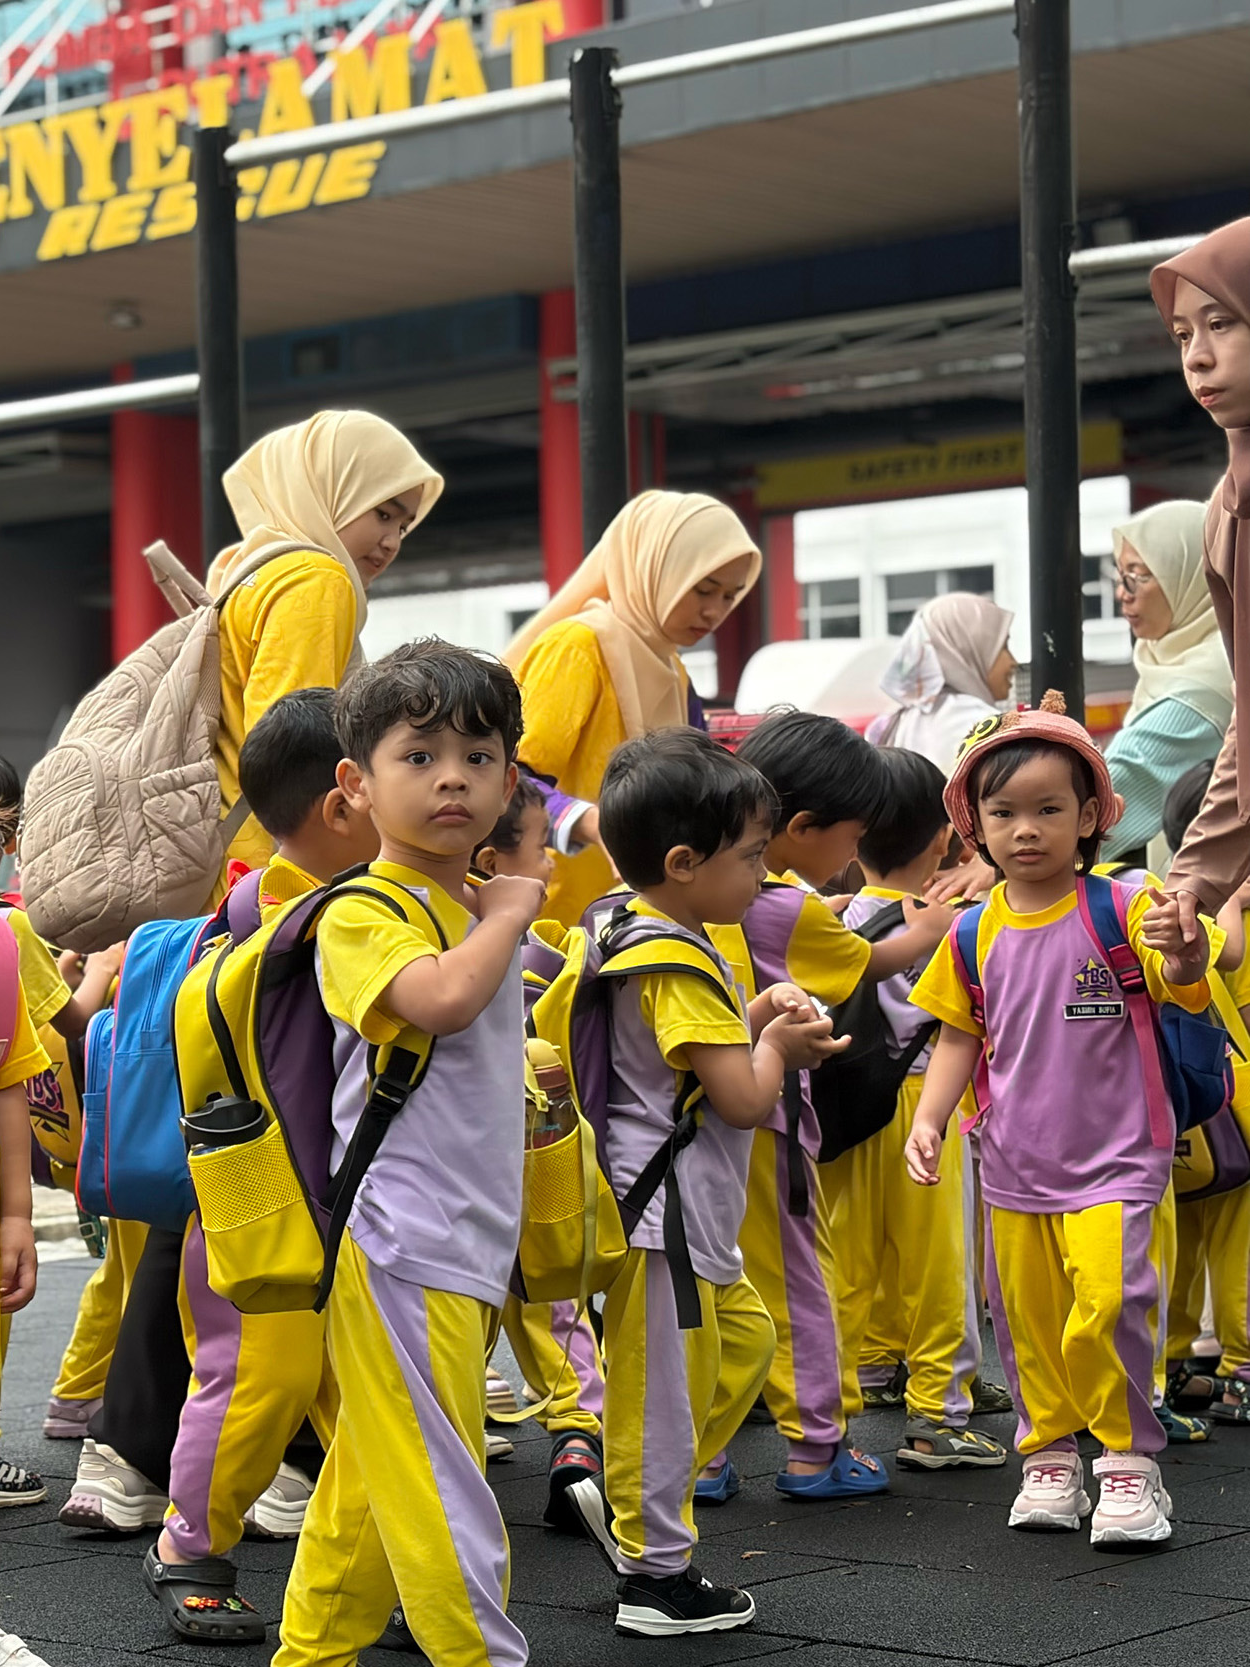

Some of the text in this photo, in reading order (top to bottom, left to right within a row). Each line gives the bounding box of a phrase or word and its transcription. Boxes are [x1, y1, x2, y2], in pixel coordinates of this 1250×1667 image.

[849, 442, 1021, 484] SAFETY FIRST
[1081, 967, 1110, 986] TBS
[27, 1068, 61, 1112] BS
